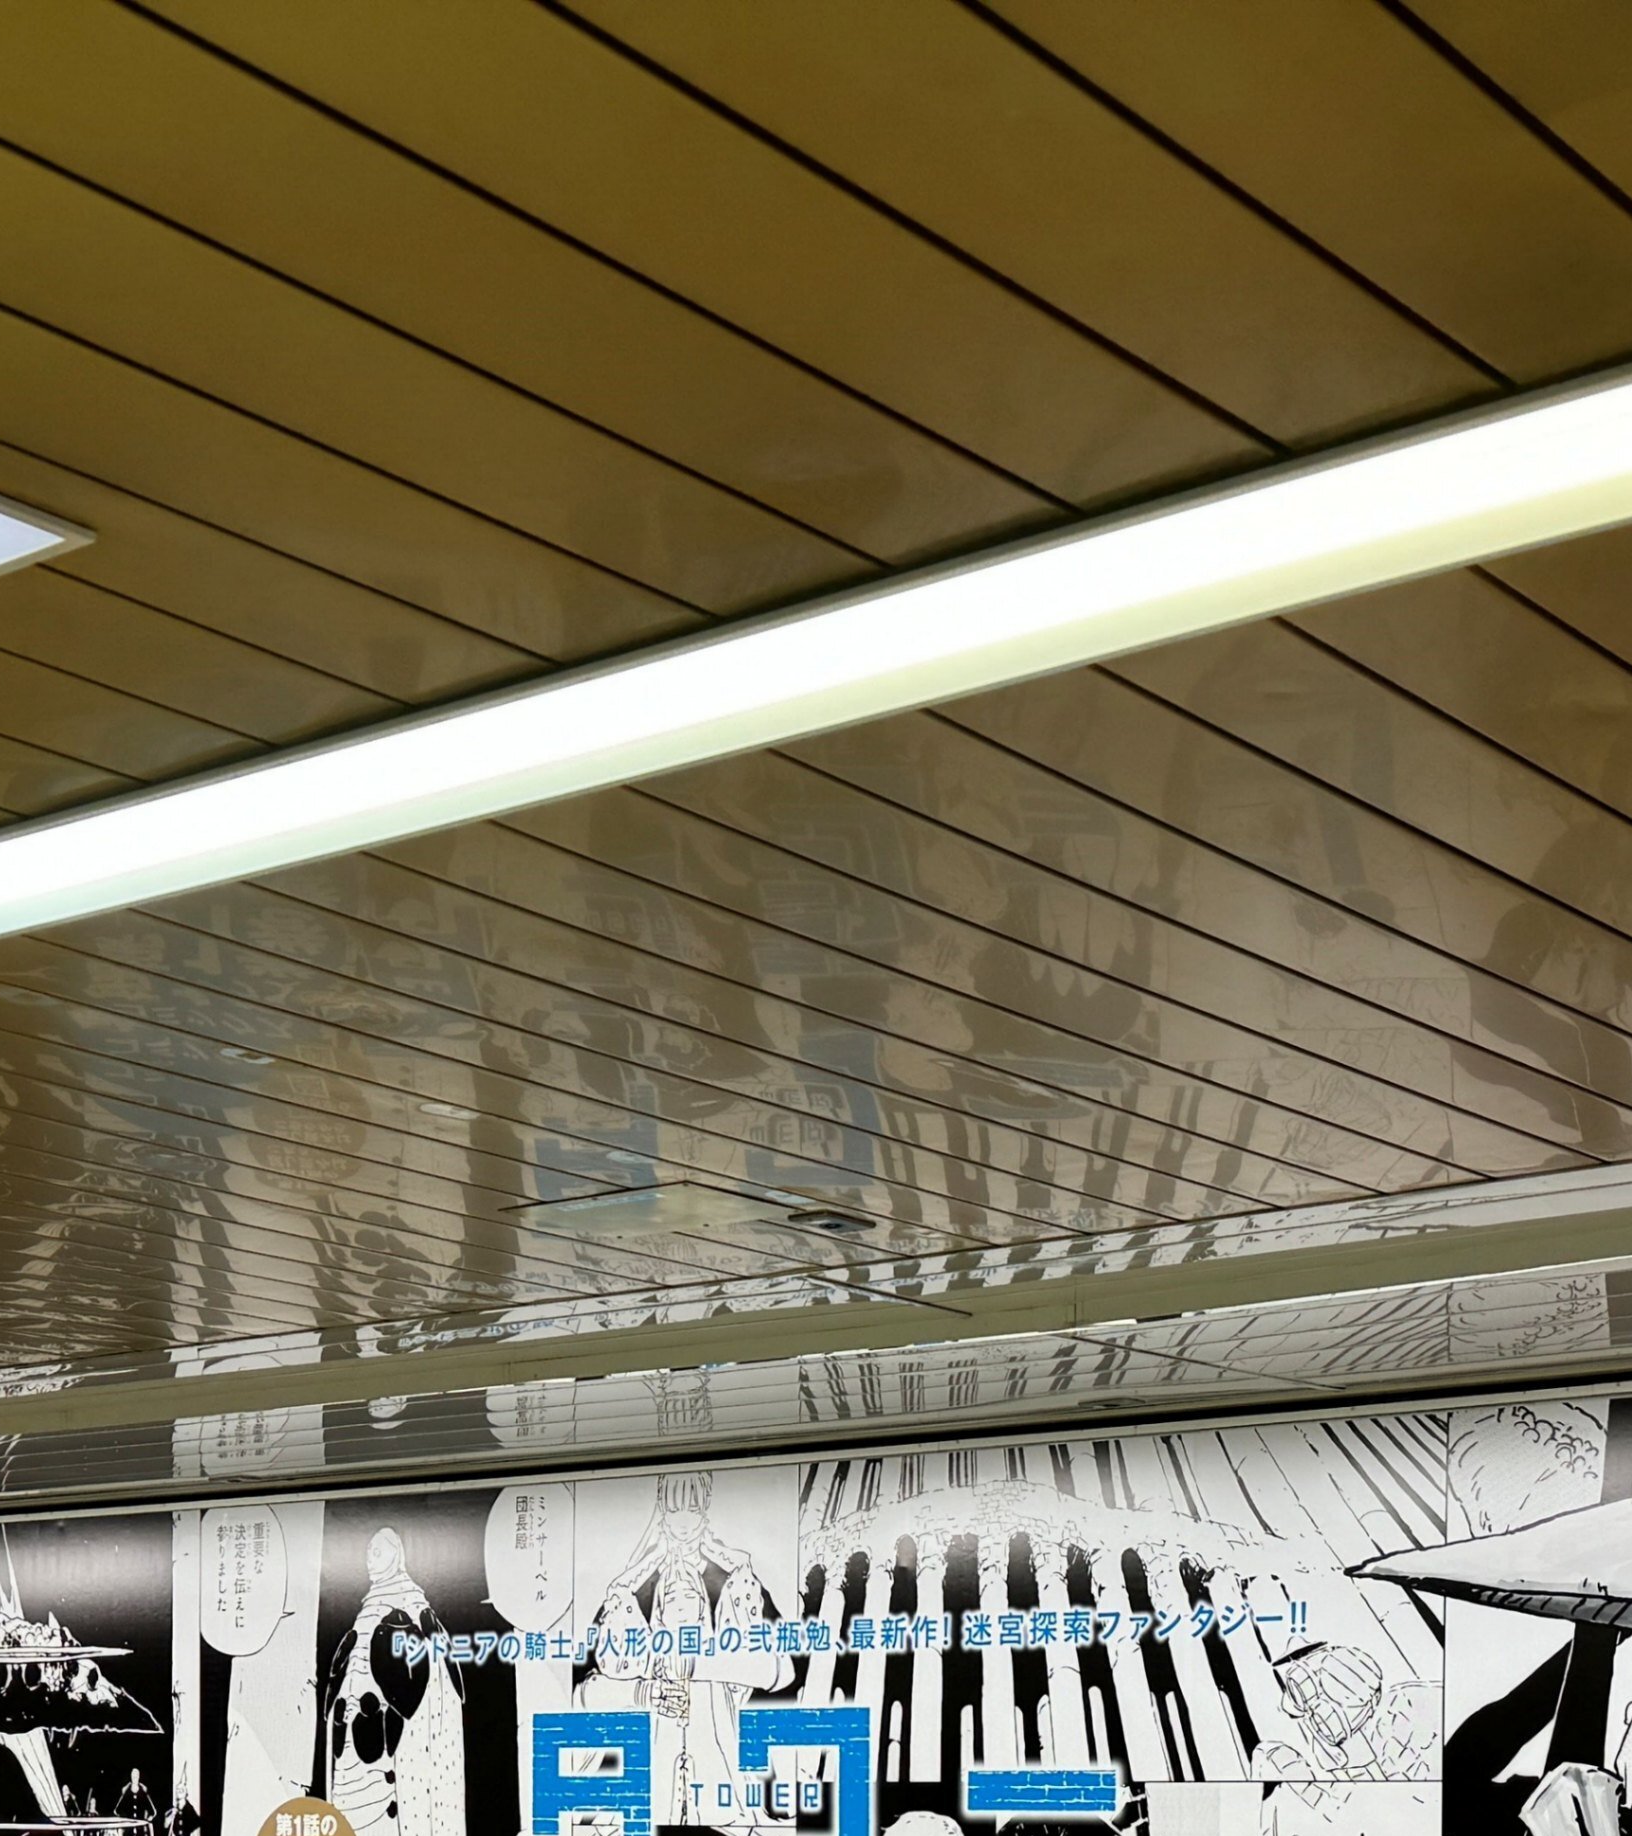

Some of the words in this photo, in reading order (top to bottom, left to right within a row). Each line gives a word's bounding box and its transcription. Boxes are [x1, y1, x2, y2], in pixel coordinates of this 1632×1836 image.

[252, 1521, 265, 1574] 重要な
[689, 1781, 824, 1809] TOWER
